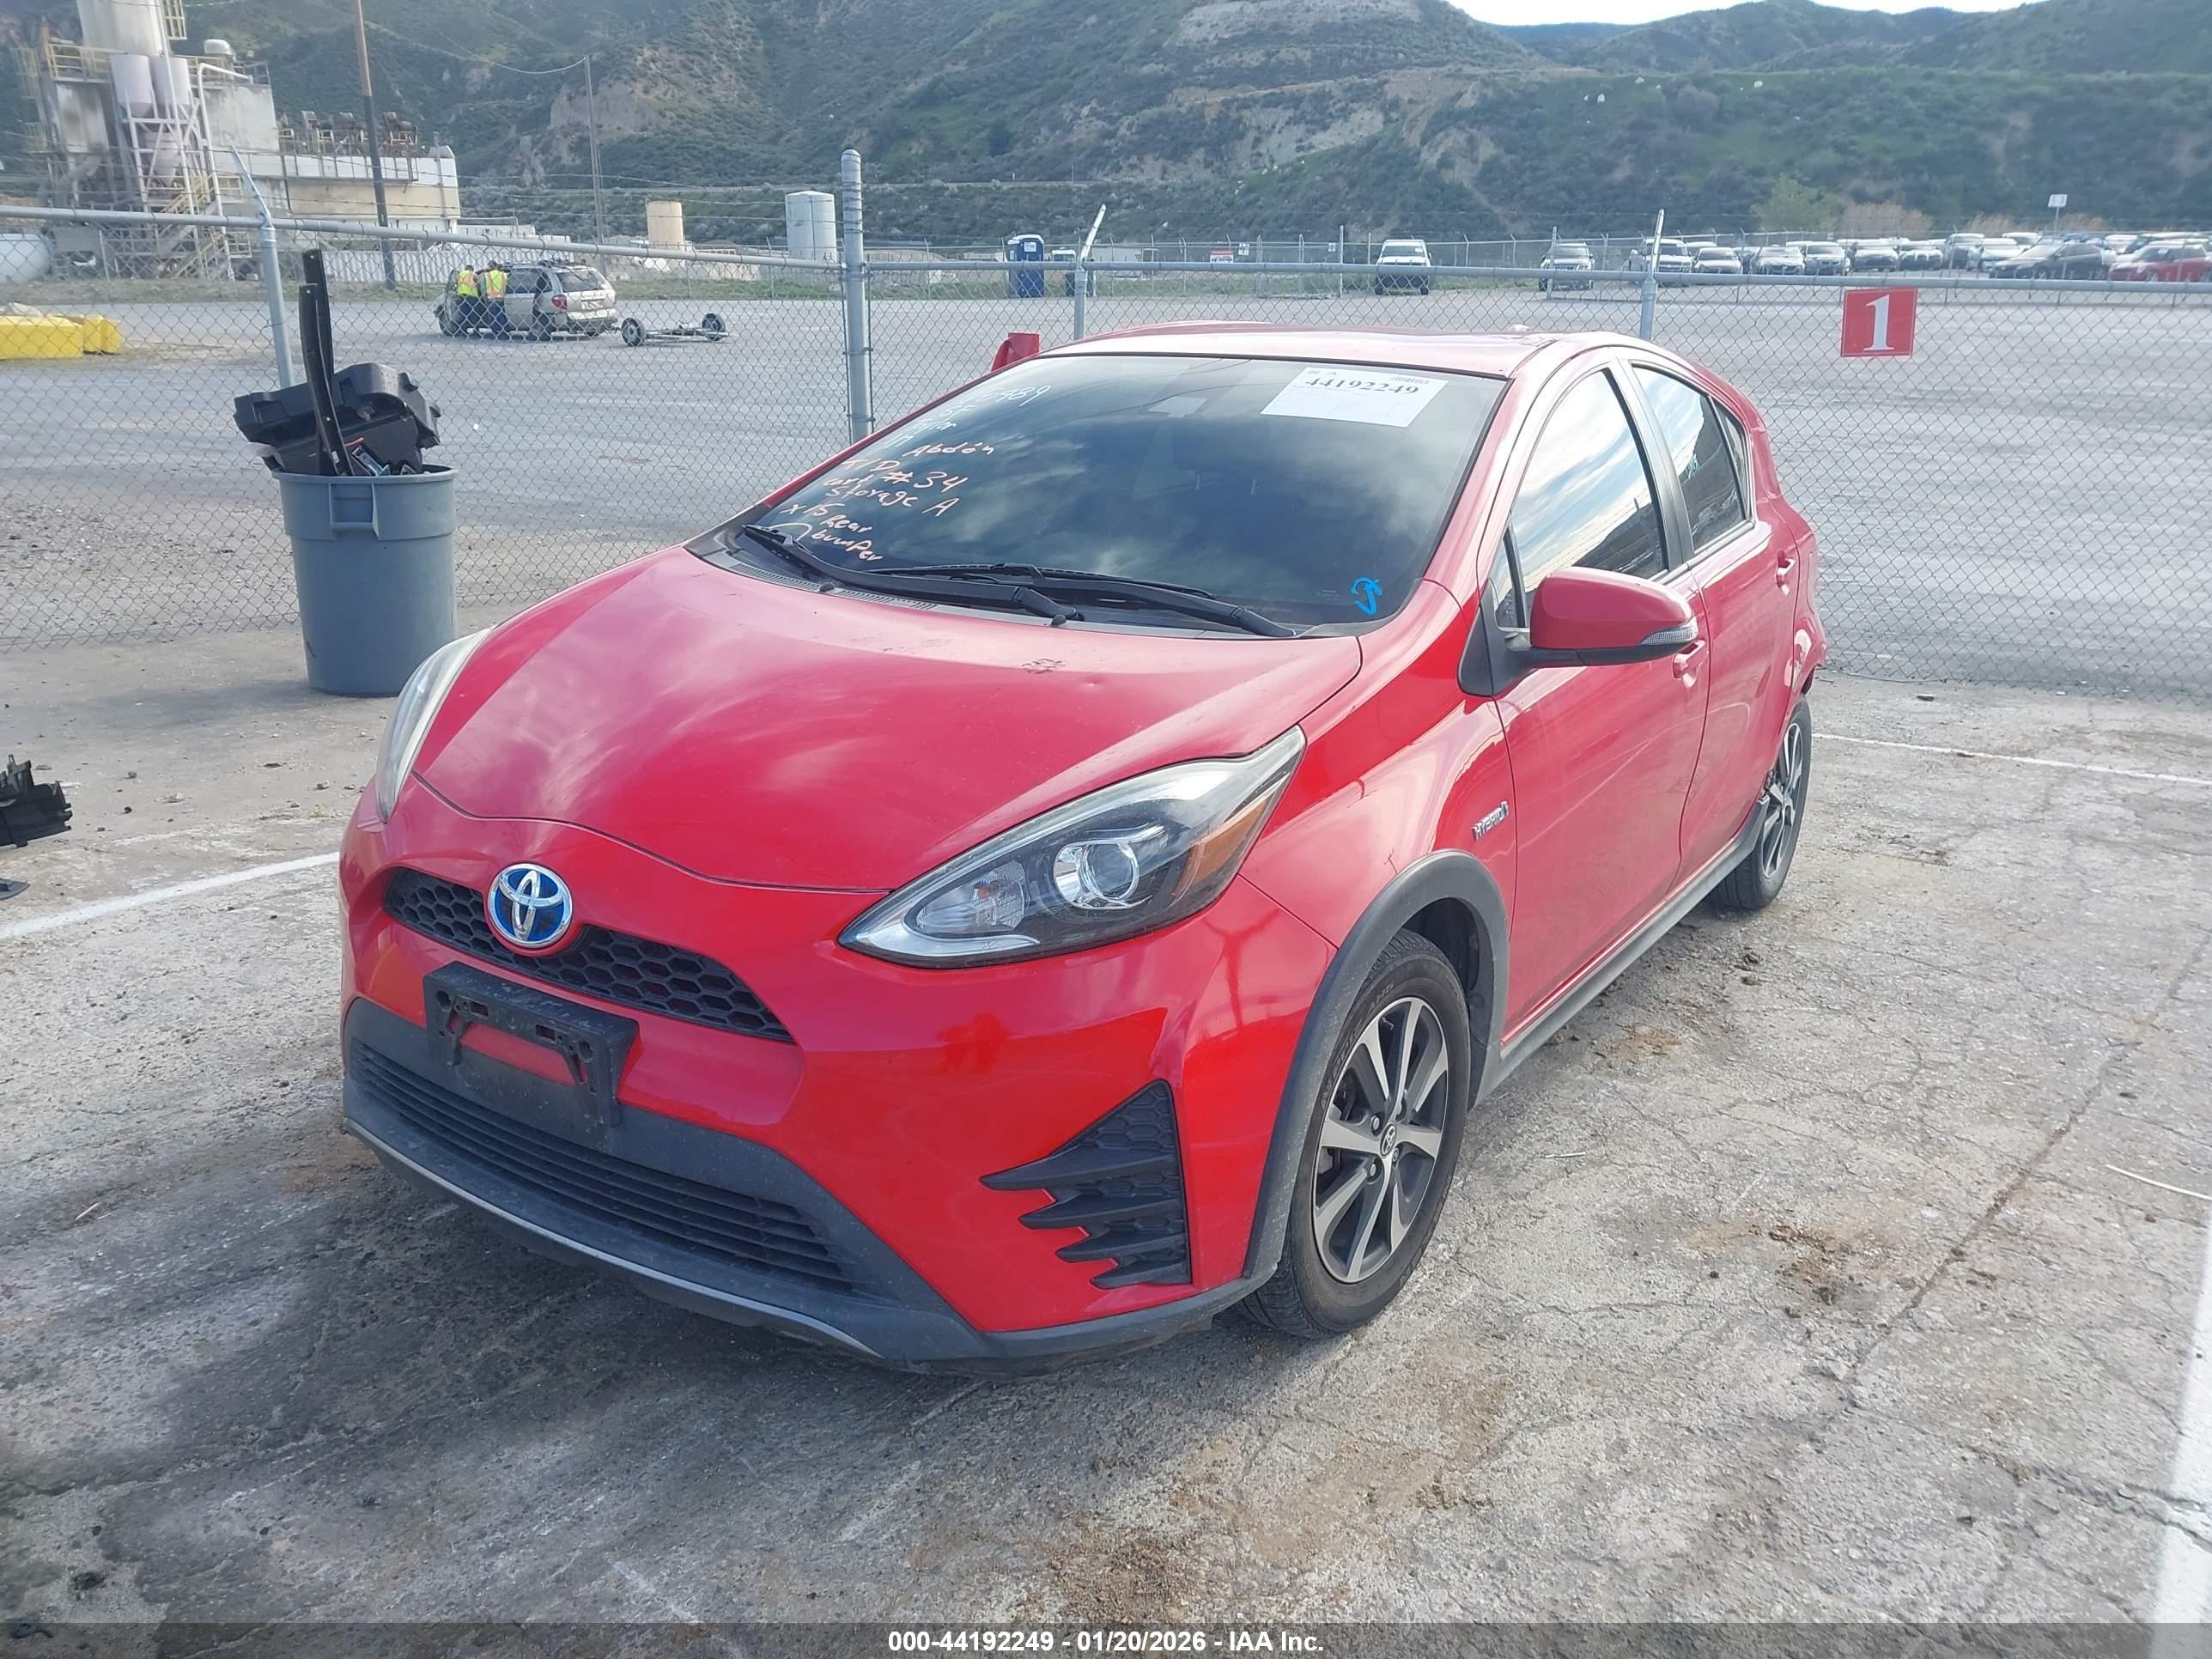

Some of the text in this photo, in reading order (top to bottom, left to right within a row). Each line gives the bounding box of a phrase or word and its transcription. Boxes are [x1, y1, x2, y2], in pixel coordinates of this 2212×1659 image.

[1863, 295, 1894, 350] 1
[1305, 378, 1419, 394] 44192249
[921, 497, 961, 517] A
